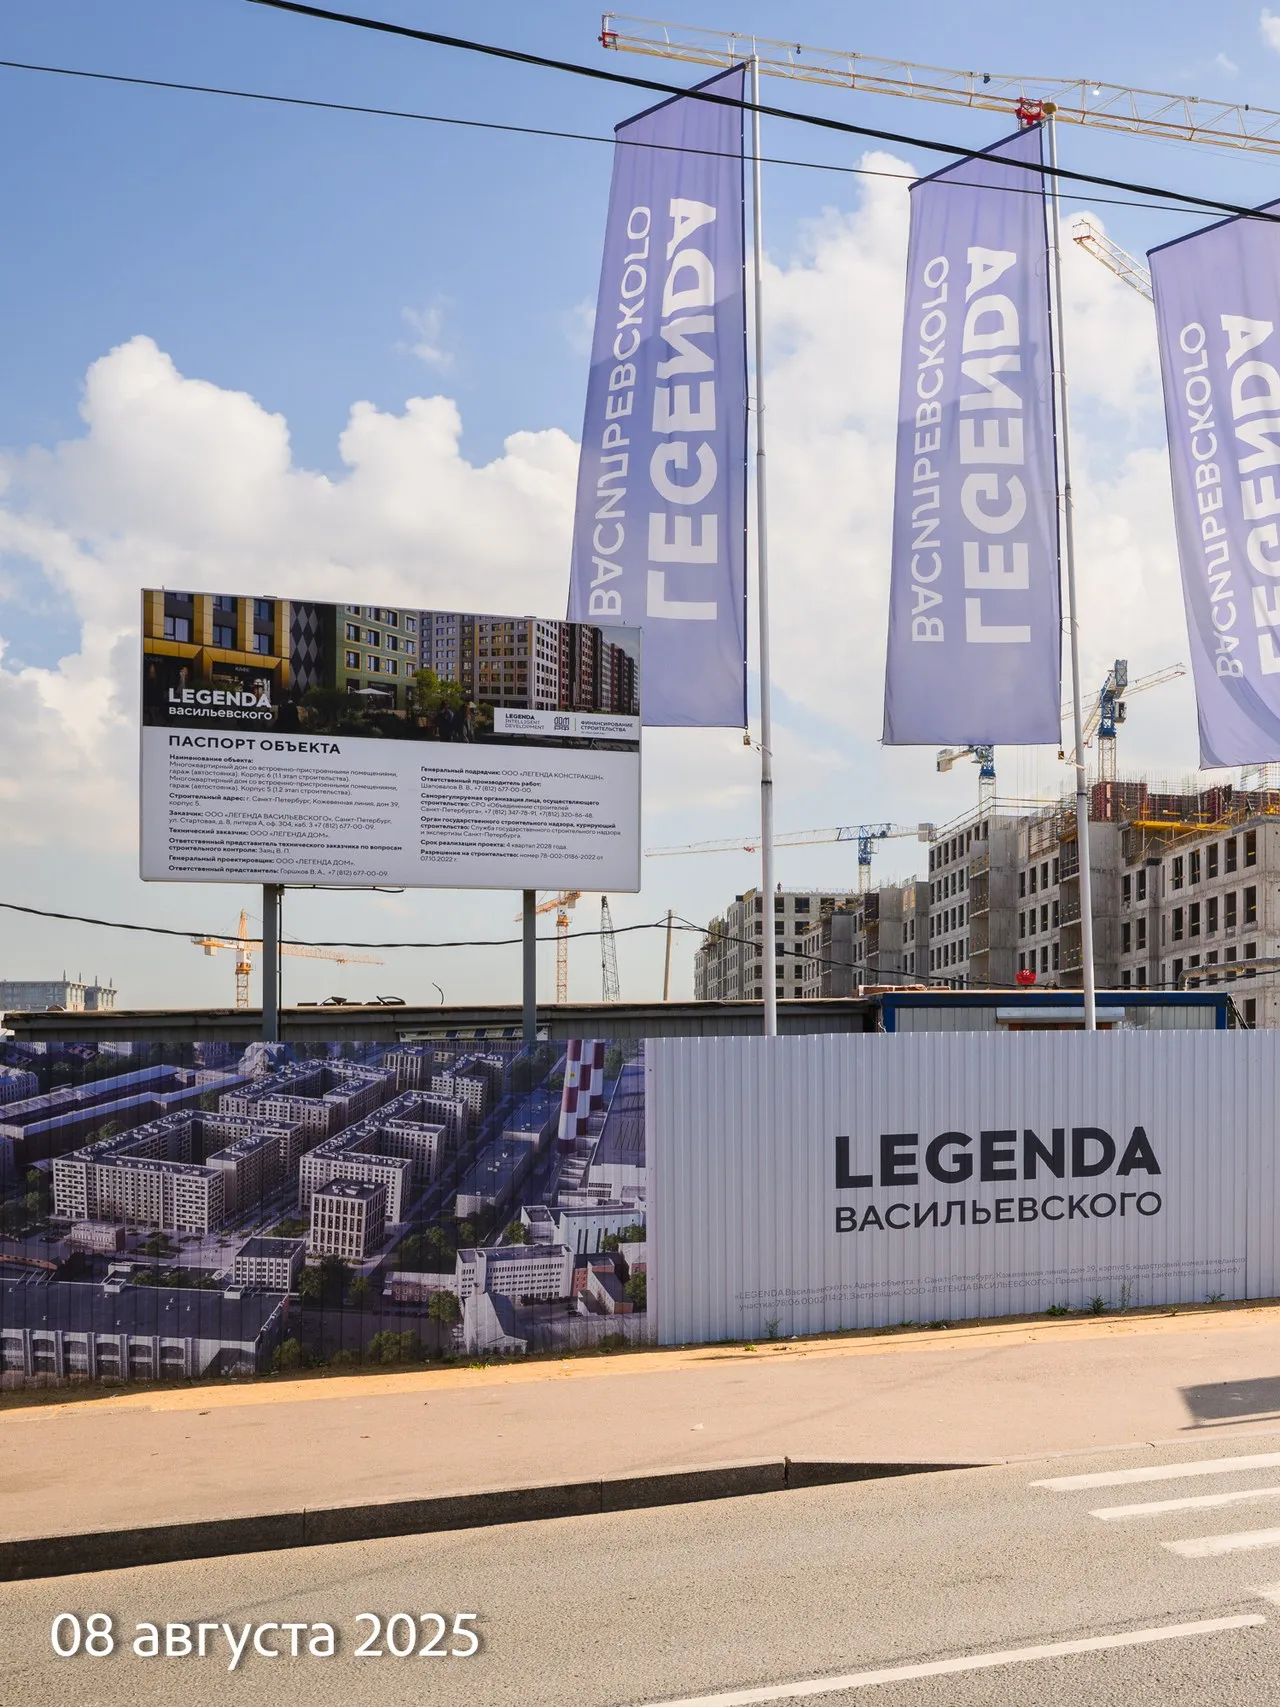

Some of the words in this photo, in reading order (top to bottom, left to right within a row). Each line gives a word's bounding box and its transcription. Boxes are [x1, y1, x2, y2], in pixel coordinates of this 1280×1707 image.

[169, 688, 271, 708] LEGENDA
[169, 706, 272, 720] васильевского
[581, 720, 633, 728] ФИНАНСИРОВАНИЕ
[169, 735, 255, 750] ПАСПОРТ
[260, 740, 341, 754] ОБЪЕКТА
[835, 1126, 1162, 1189] LEGENDA
[835, 1191, 1163, 1233] ВАСИЛЬЕВСКОГО
